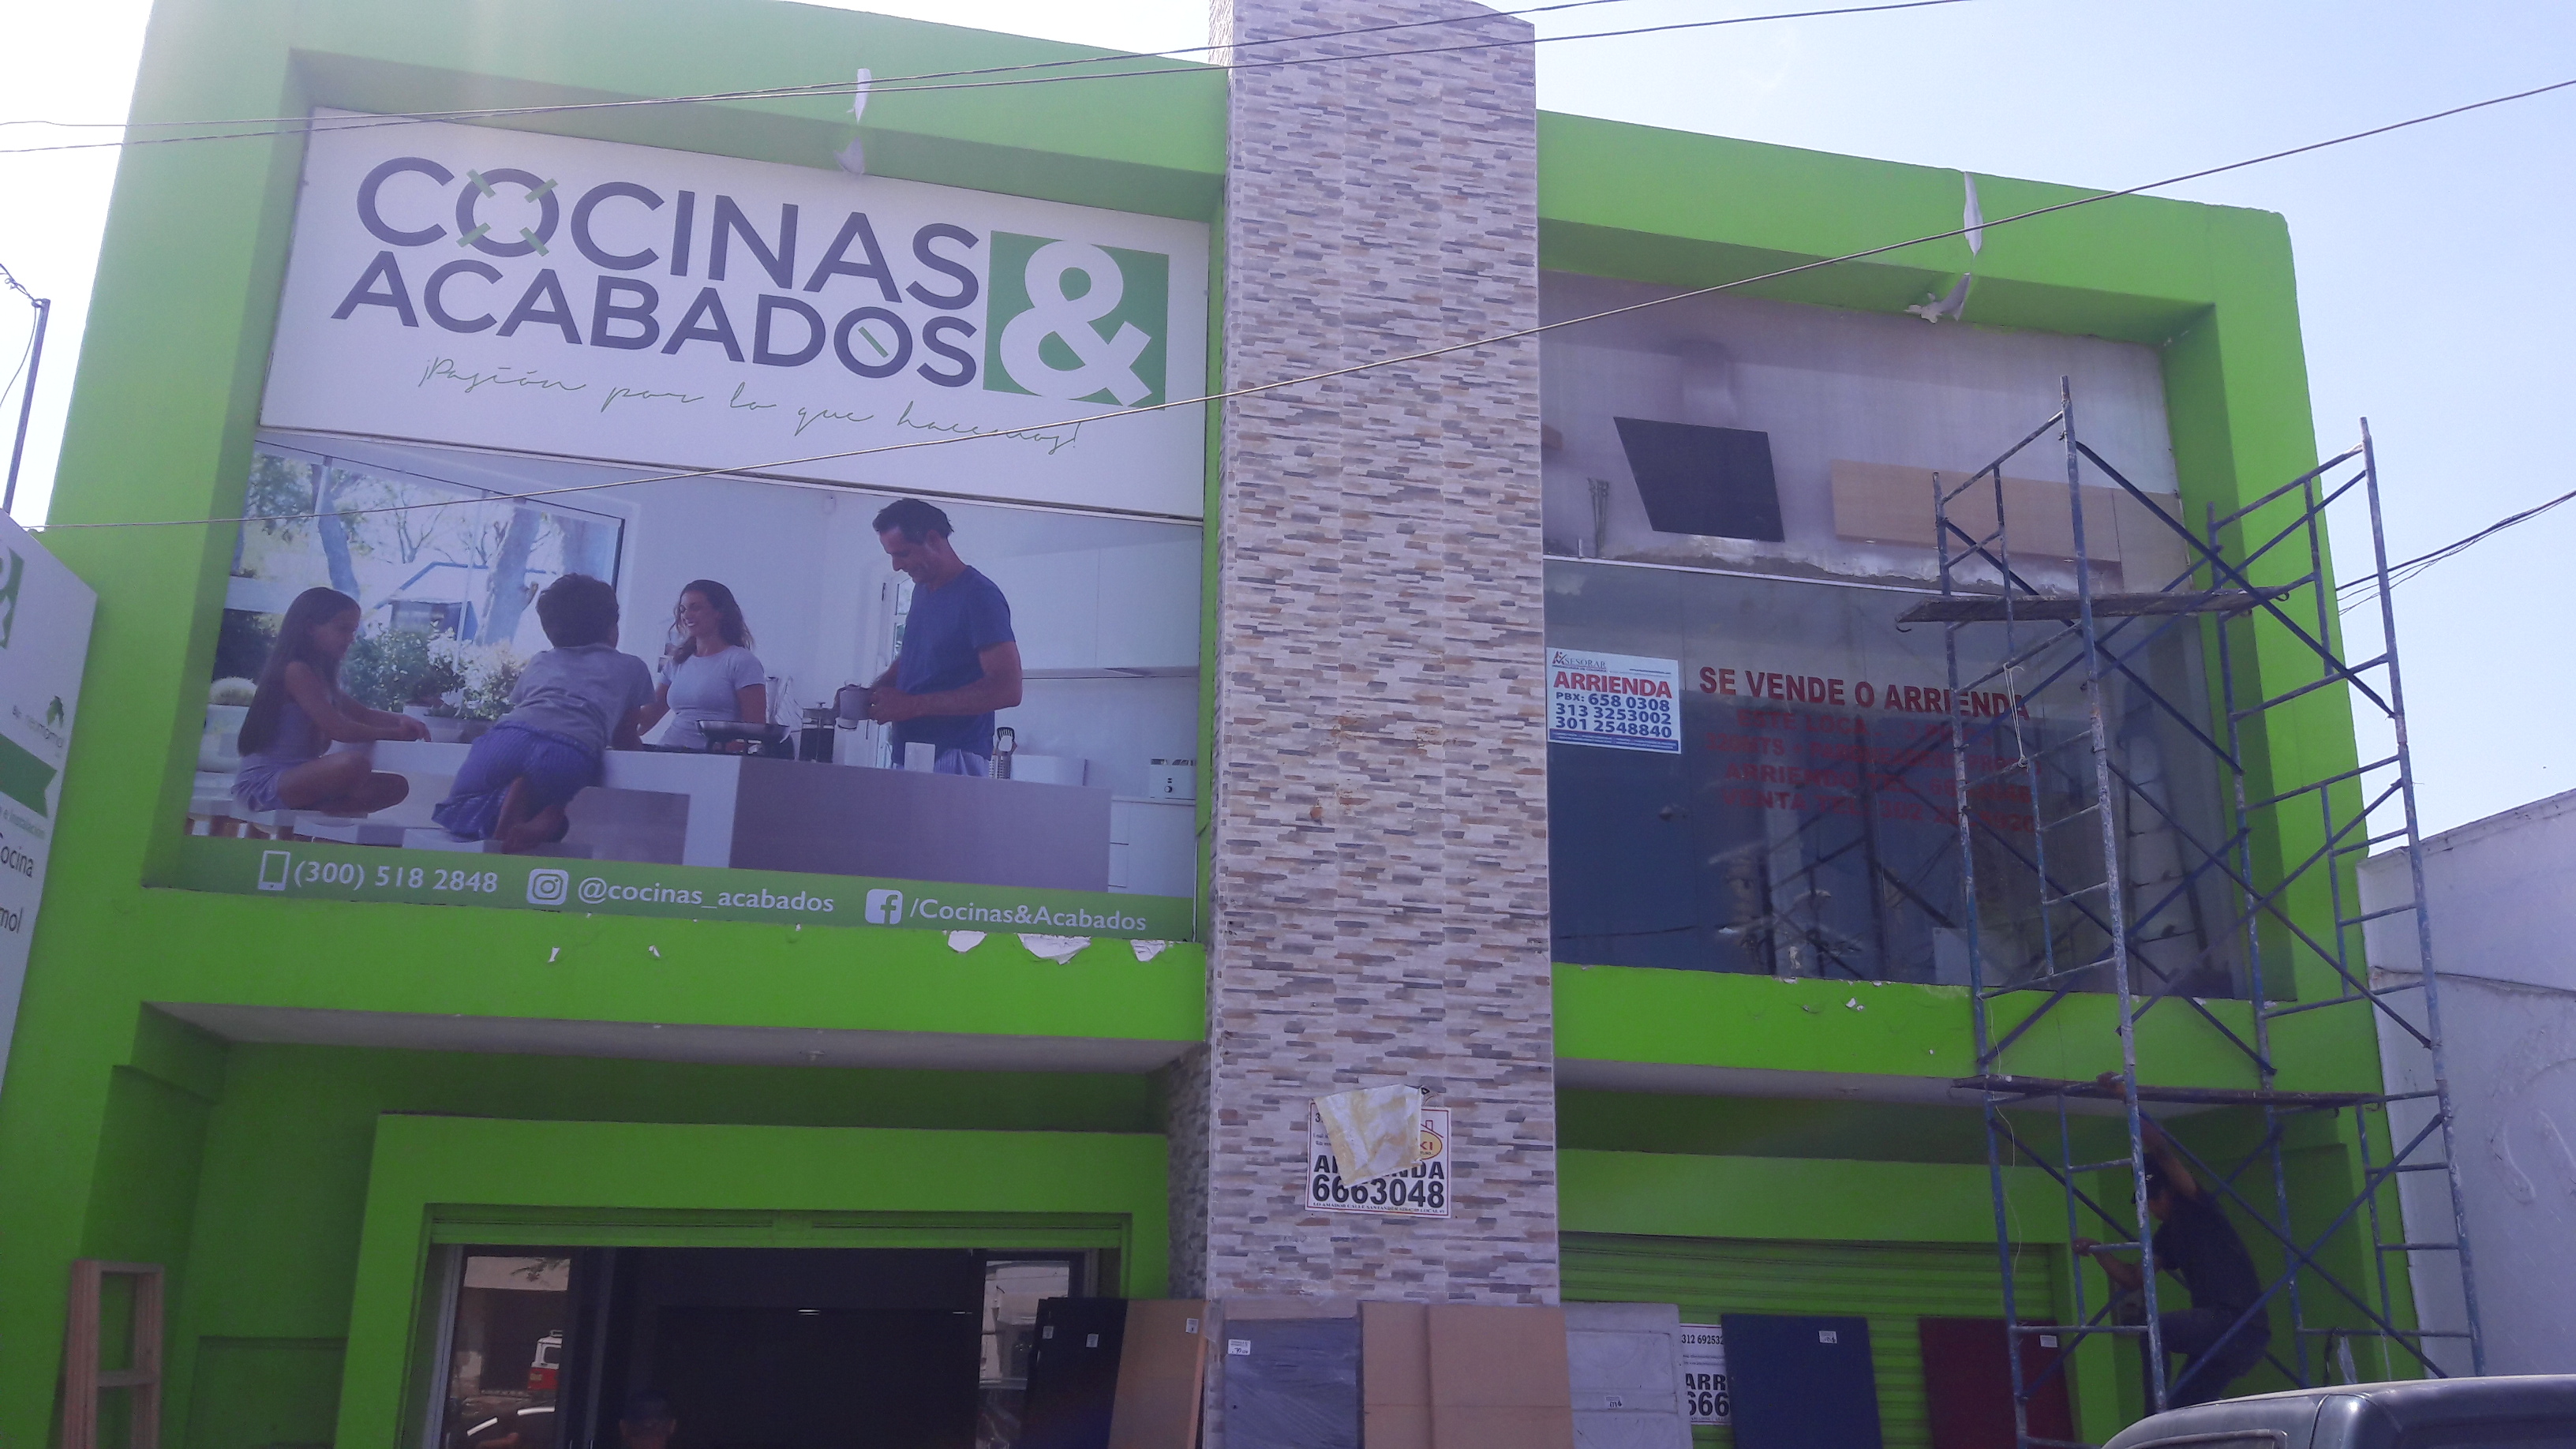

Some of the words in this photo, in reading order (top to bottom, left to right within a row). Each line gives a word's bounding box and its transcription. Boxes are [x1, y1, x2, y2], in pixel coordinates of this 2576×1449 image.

[356, 157, 979, 311] COCINAS
[330, 251, 978, 388] ACABADOS
[999, 240, 1151, 407] &
[601, 387, 704, 413] por
[730, 382, 777, 409] lo
[795, 406, 874, 436] que
[1553, 671, 1672, 699] ARRIENDA
[1556, 691, 1585, 702] PBX:
[1588, 693, 1621, 707] 658
[1626, 696, 1670, 712] 0308
[1698, 666, 1735, 695] SE
[1745, 670, 1846, 707] VENDE
[1855, 681, 1874, 709] O
[1885, 684, 2030, 720] ARRIENDA
[1556, 702, 1588, 717] 313
[1593, 706, 1672, 724] 3253002
[1556, 716, 1587, 730] 301
[1593, 720, 1672, 738] 2548840
[1737, 709, 1796, 730] ESTE
[1806, 713, 1882, 736] LOCA
[1724, 762, 1858, 788] ARRIENDO
[1721, 788, 1808, 811] VENTA
[0, 833, 33, 878] ocina
[294, 860, 365, 891] (300)
[375, 865, 424, 889] 518
[433, 869, 498, 894] 2848
[578, 876, 834, 913] @cocinas_acabados
[910, 897, 1147, 931] /Cocinas&Acabados
[1312, 1174, 1445, 1208] 6663048
[1681, 1334, 1695, 1344] 312
